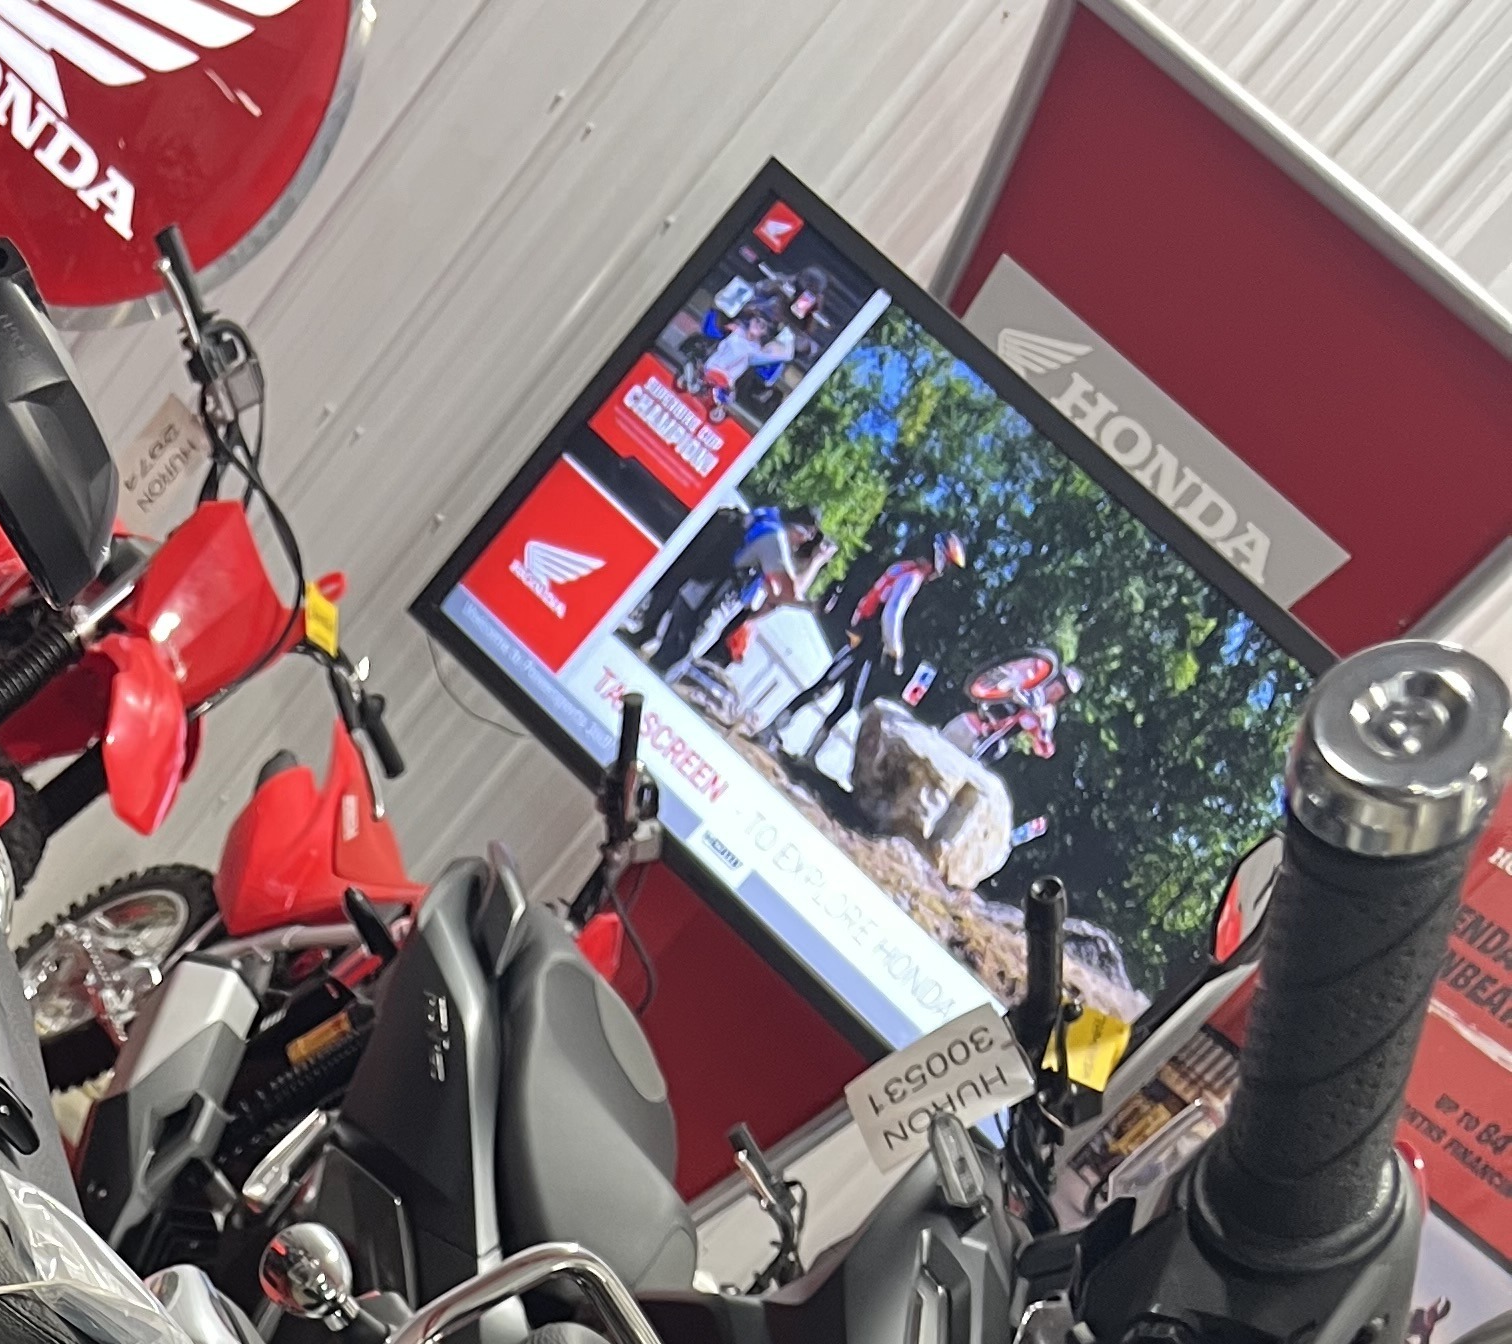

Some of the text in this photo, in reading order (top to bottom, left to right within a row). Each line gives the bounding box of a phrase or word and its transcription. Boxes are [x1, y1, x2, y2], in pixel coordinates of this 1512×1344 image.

[1050, 371, 1274, 585] HONDA
[639, 711, 730, 803] SCREEN
[866, 1025, 994, 1118] 300531
